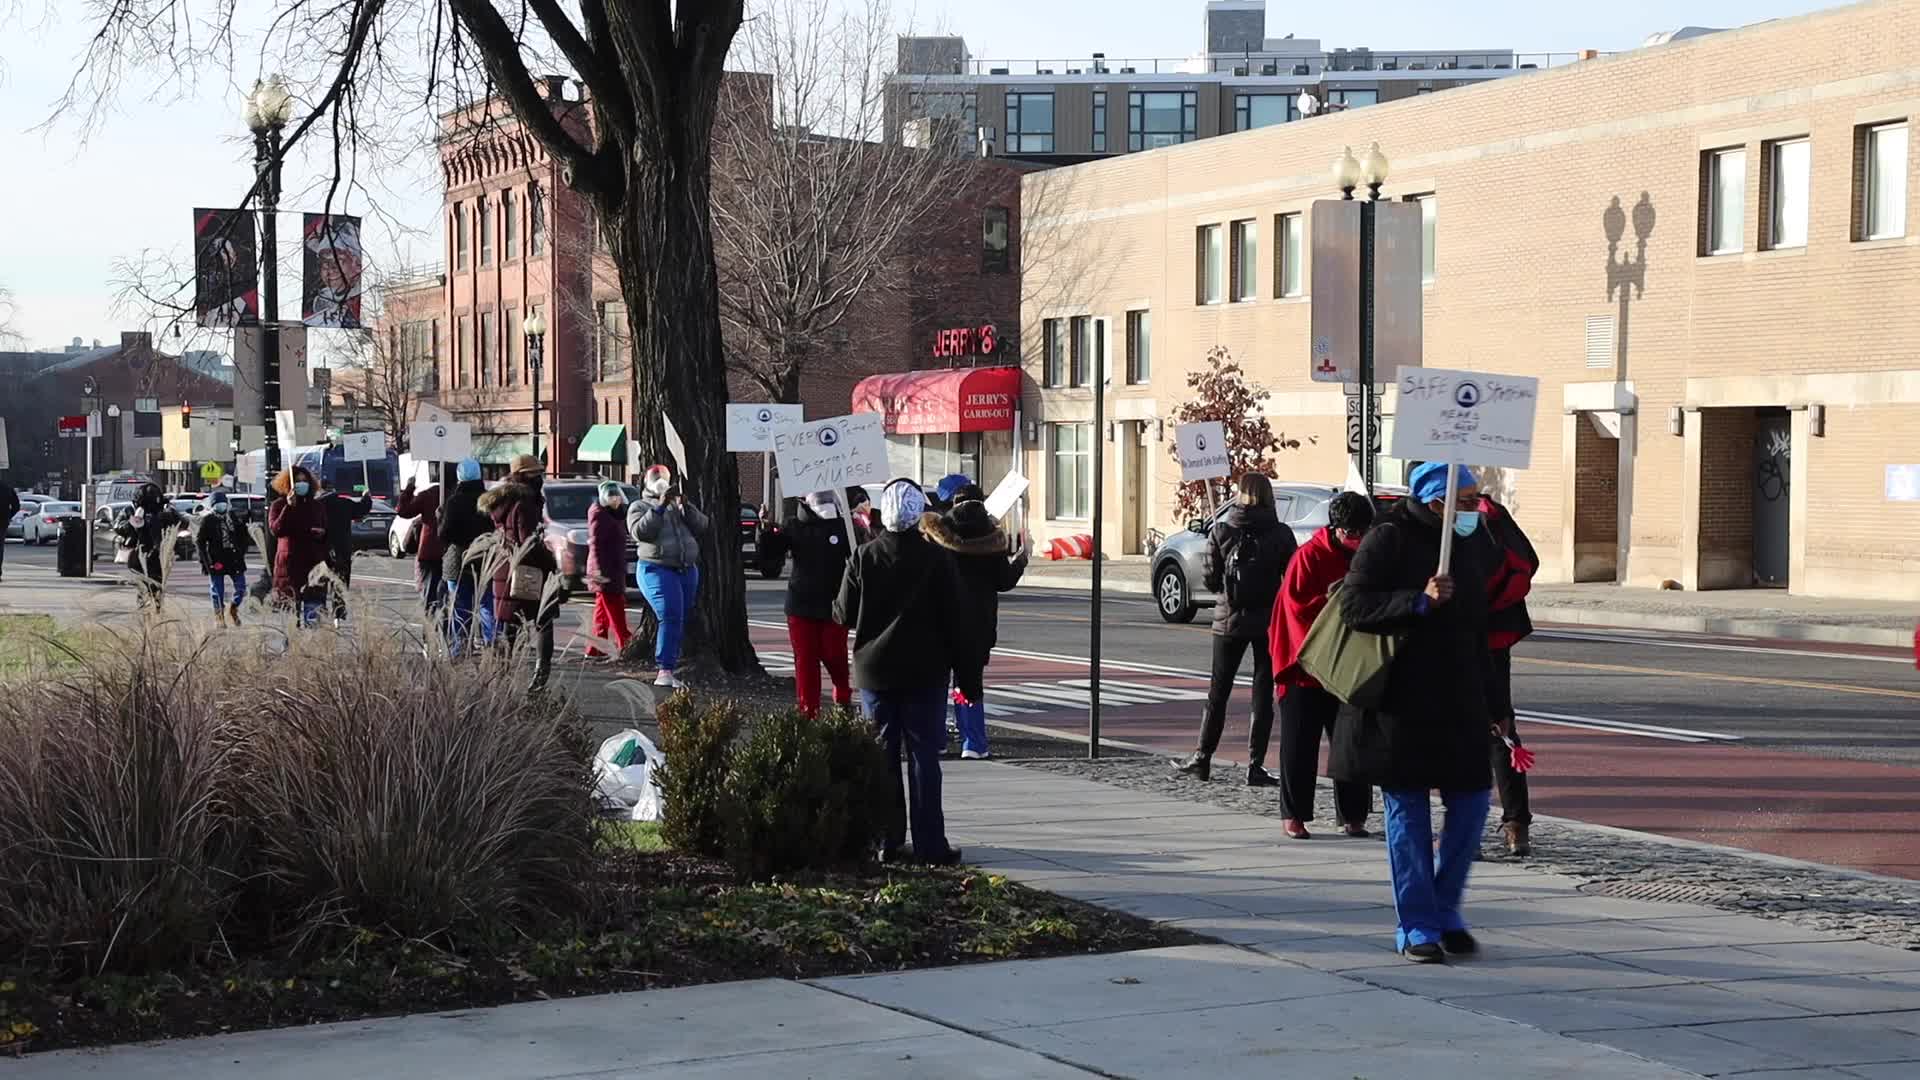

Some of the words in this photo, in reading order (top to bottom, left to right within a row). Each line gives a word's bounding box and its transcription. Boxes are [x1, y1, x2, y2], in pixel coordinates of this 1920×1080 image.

[933, 325, 994, 357] JERRY'S
[966, 393, 1009, 406] JERRY'S
[1349, 400, 1380, 414] SOH
[963, 408, 1010, 419] CARRY-OUT
[775, 431, 816, 453] EVER
[814, 461, 873, 488] NURSE
